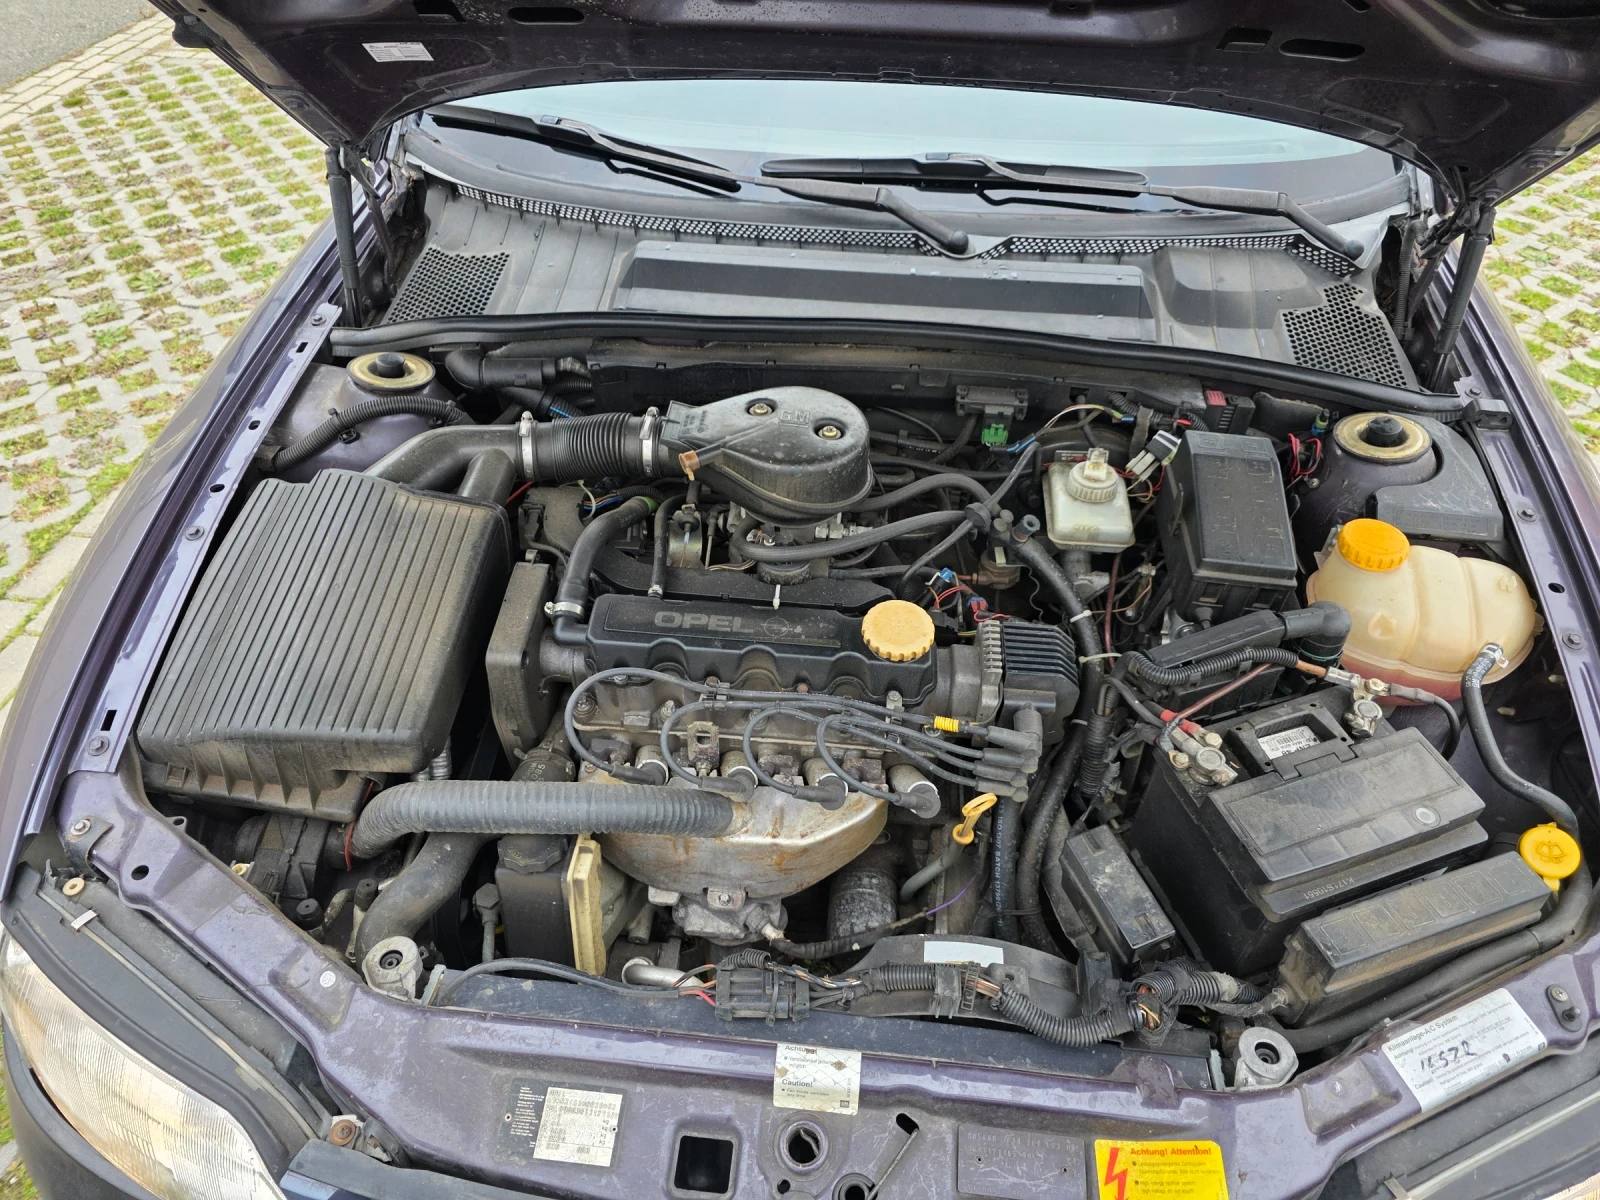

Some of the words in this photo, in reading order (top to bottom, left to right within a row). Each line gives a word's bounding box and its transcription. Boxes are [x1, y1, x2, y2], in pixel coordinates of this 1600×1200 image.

[779, 410, 810, 424] GM
[654, 611, 754, 633] OPEL
[1303, 877, 1355, 900] K171S10551
[1386, 1024, 1437, 1053] Klimaanlage-A/C
[1435, 1013, 1459, 1029] System
[782, 1079, 813, 1087] Caution!
[1130, 1147, 1168, 1156] Achtung!
[1170, 1147, 1211, 1155] Attention!
